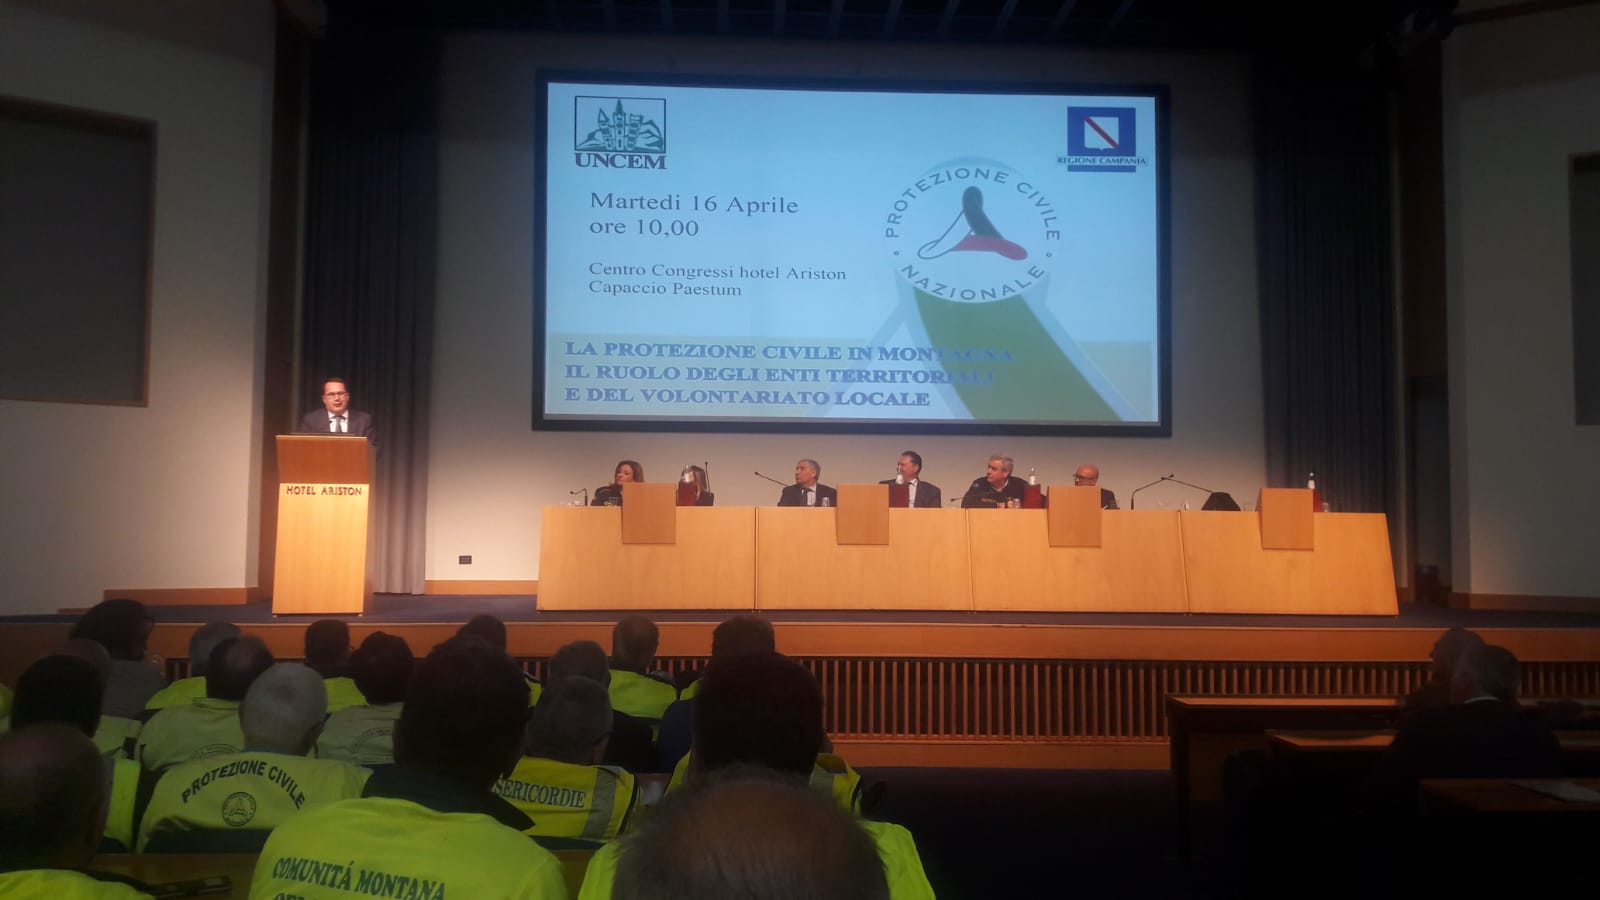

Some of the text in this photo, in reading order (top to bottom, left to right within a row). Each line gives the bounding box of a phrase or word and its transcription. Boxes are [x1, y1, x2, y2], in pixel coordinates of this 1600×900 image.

[575, 152, 667, 170] UNCEM
[1057, 157, 1147, 165] REGIONE CAMPANIA
[590, 191, 799, 217] Martedi 16 Aprile
[885, 167, 1061, 241] PROTEZIONE CIVILE
[589, 219, 700, 238] ore 10,00
[588, 262, 847, 281] Centro Congressi hotel Ariston
[588, 280, 742, 297] Capaccio Paestum
[901, 264, 1045, 301] NAZIONALE
[565, 341, 1014, 362] LA PROTEZIONE CIVILE IN MONTAGNA
[565, 365, 996, 384] IL RUOLO DEGLI ENTI TERRITORIALI
[565, 388, 931, 407] E DEL VOLONTARIATO LOCALE
[286, 485, 362, 497] HOTEL ARISTON
[182, 759, 268, 804] PROTEZIONE
[268, 765, 306, 811] CIVILE
[493, 777, 587, 809] SERICORDIE
[353, 869, 446, 900] MONTANA
